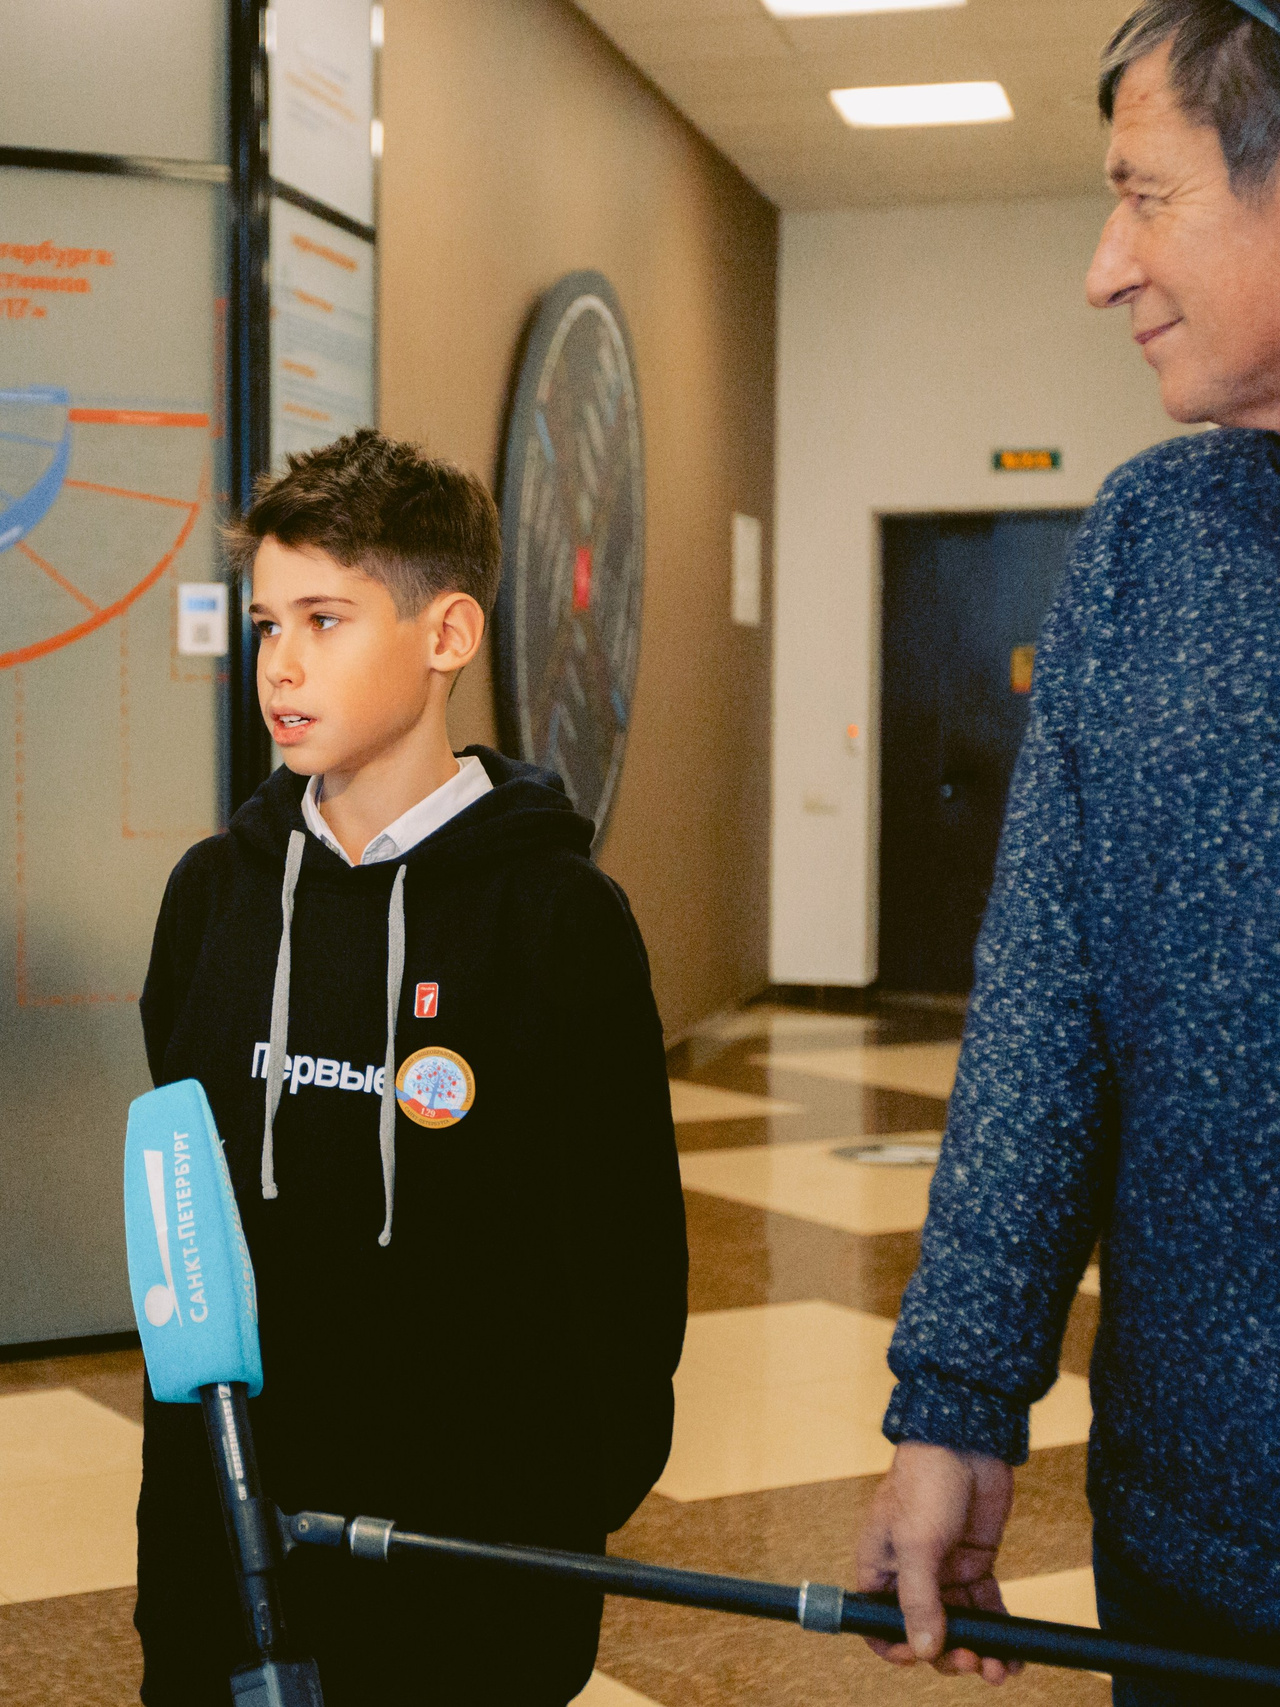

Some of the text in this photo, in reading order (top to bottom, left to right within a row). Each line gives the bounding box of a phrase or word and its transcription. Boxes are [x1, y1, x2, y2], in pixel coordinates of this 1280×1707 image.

[421, 1107, 436, 1118] 129
[174, 1131, 208, 1323] САНКТ-ПЕТЕРБУРГ
[222, 1400, 244, 1480] SENNHEISER
